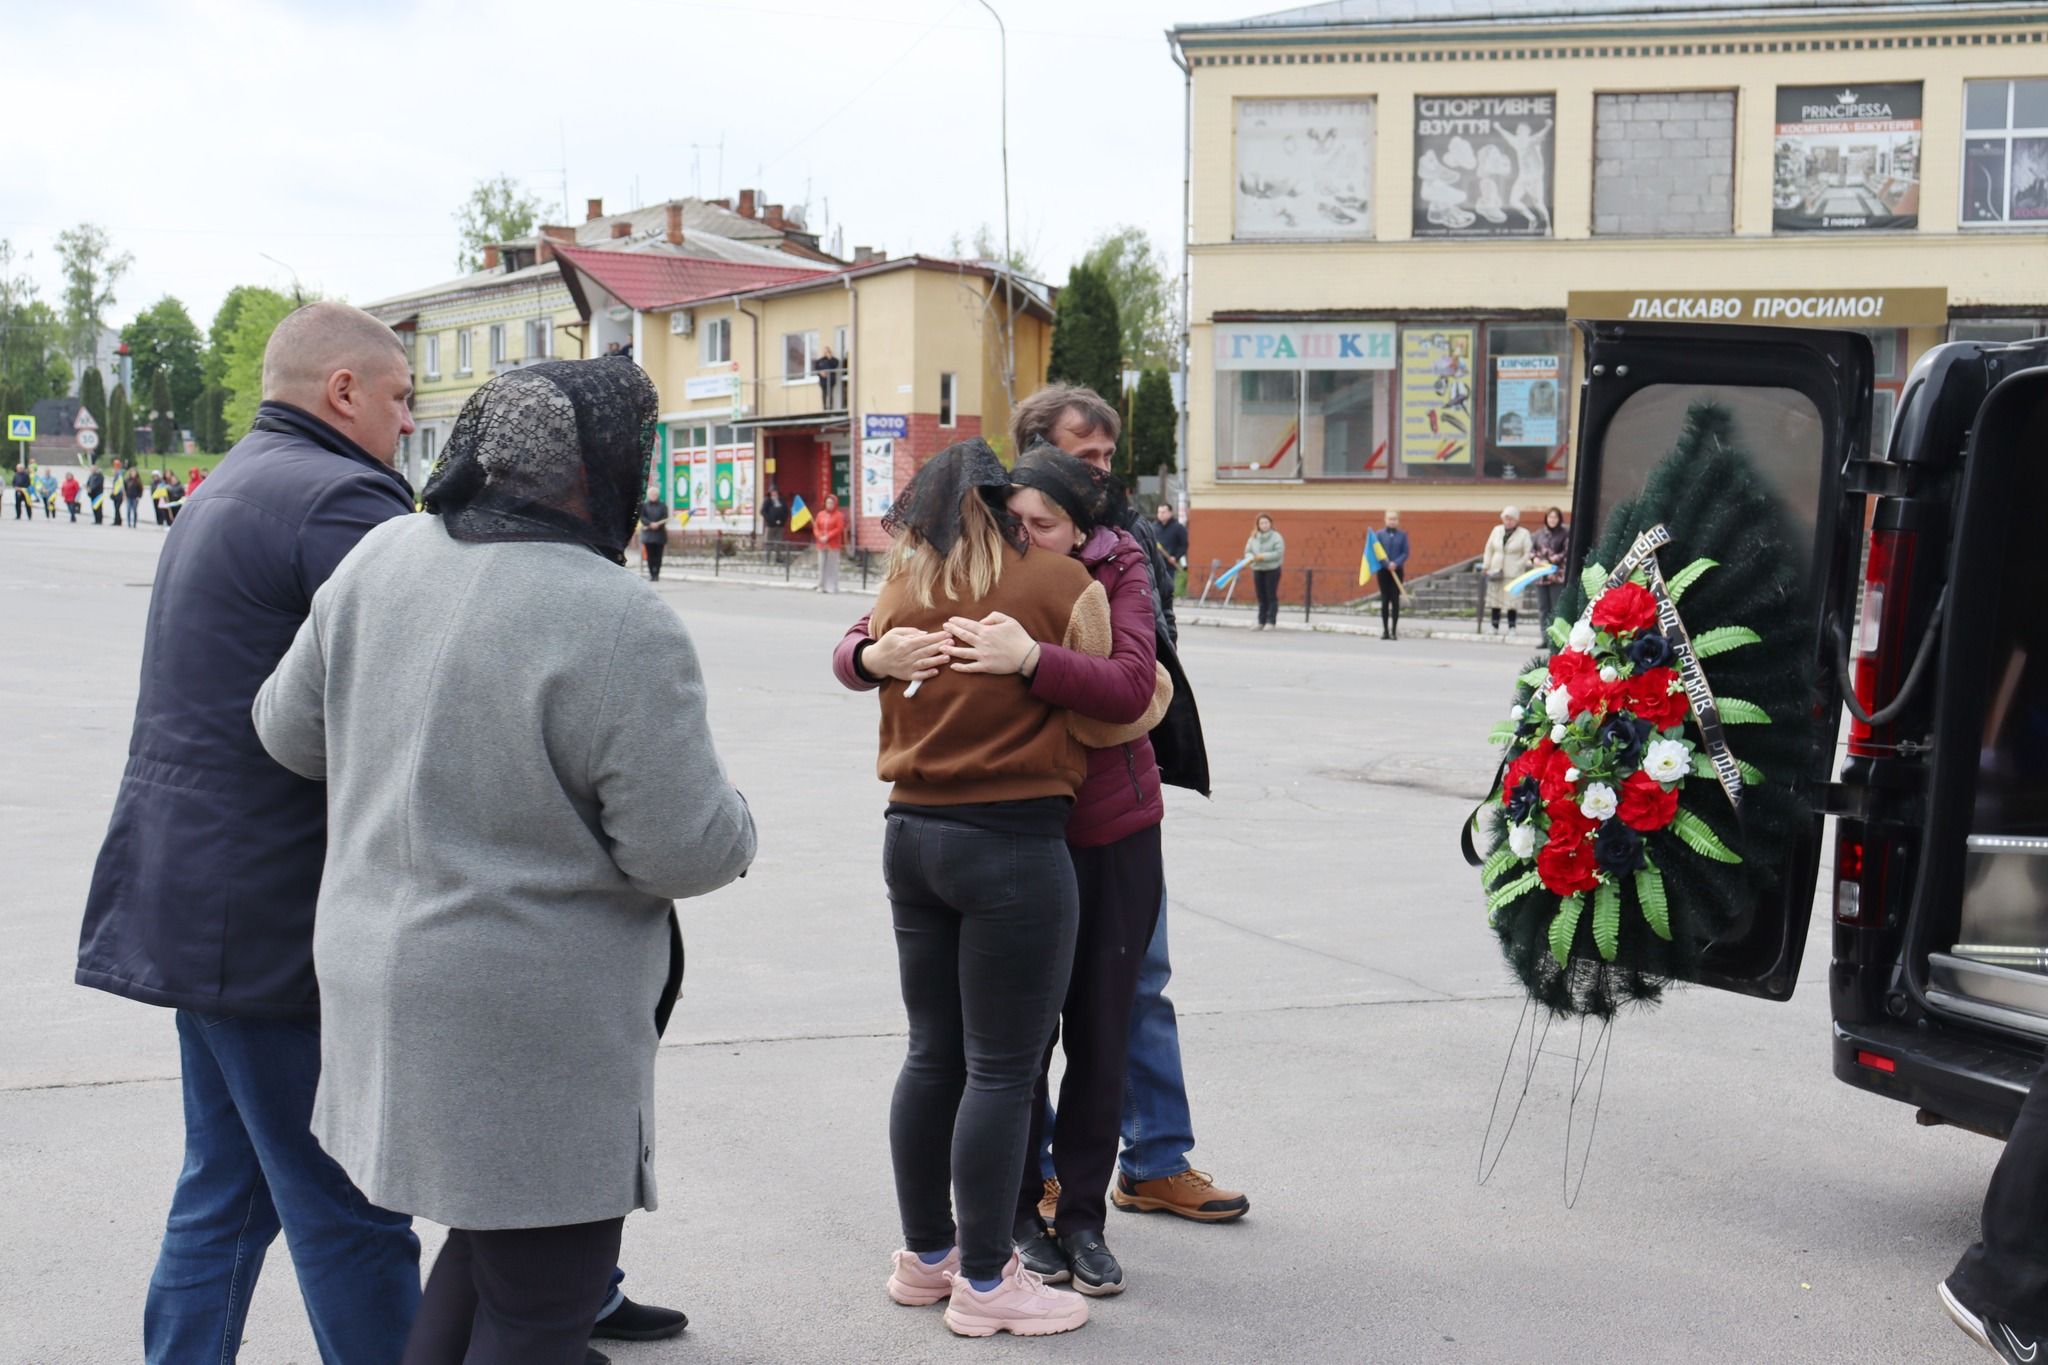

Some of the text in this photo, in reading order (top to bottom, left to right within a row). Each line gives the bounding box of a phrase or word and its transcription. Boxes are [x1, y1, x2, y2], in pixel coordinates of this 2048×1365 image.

[1419, 98, 1553, 117] СПОРТИВНЕ
[1801, 103, 1893, 119] PRINCIPESSA
[1418, 119, 1491, 136] ВЗУТТЯ
[1822, 217, 1829, 227] 2
[1628, 297, 1884, 318] ЛАСКАВО ПРОСИМО!
[1217, 333, 1392, 358] ІГРАШКИ
[867, 416, 905, 429] ФОТО
